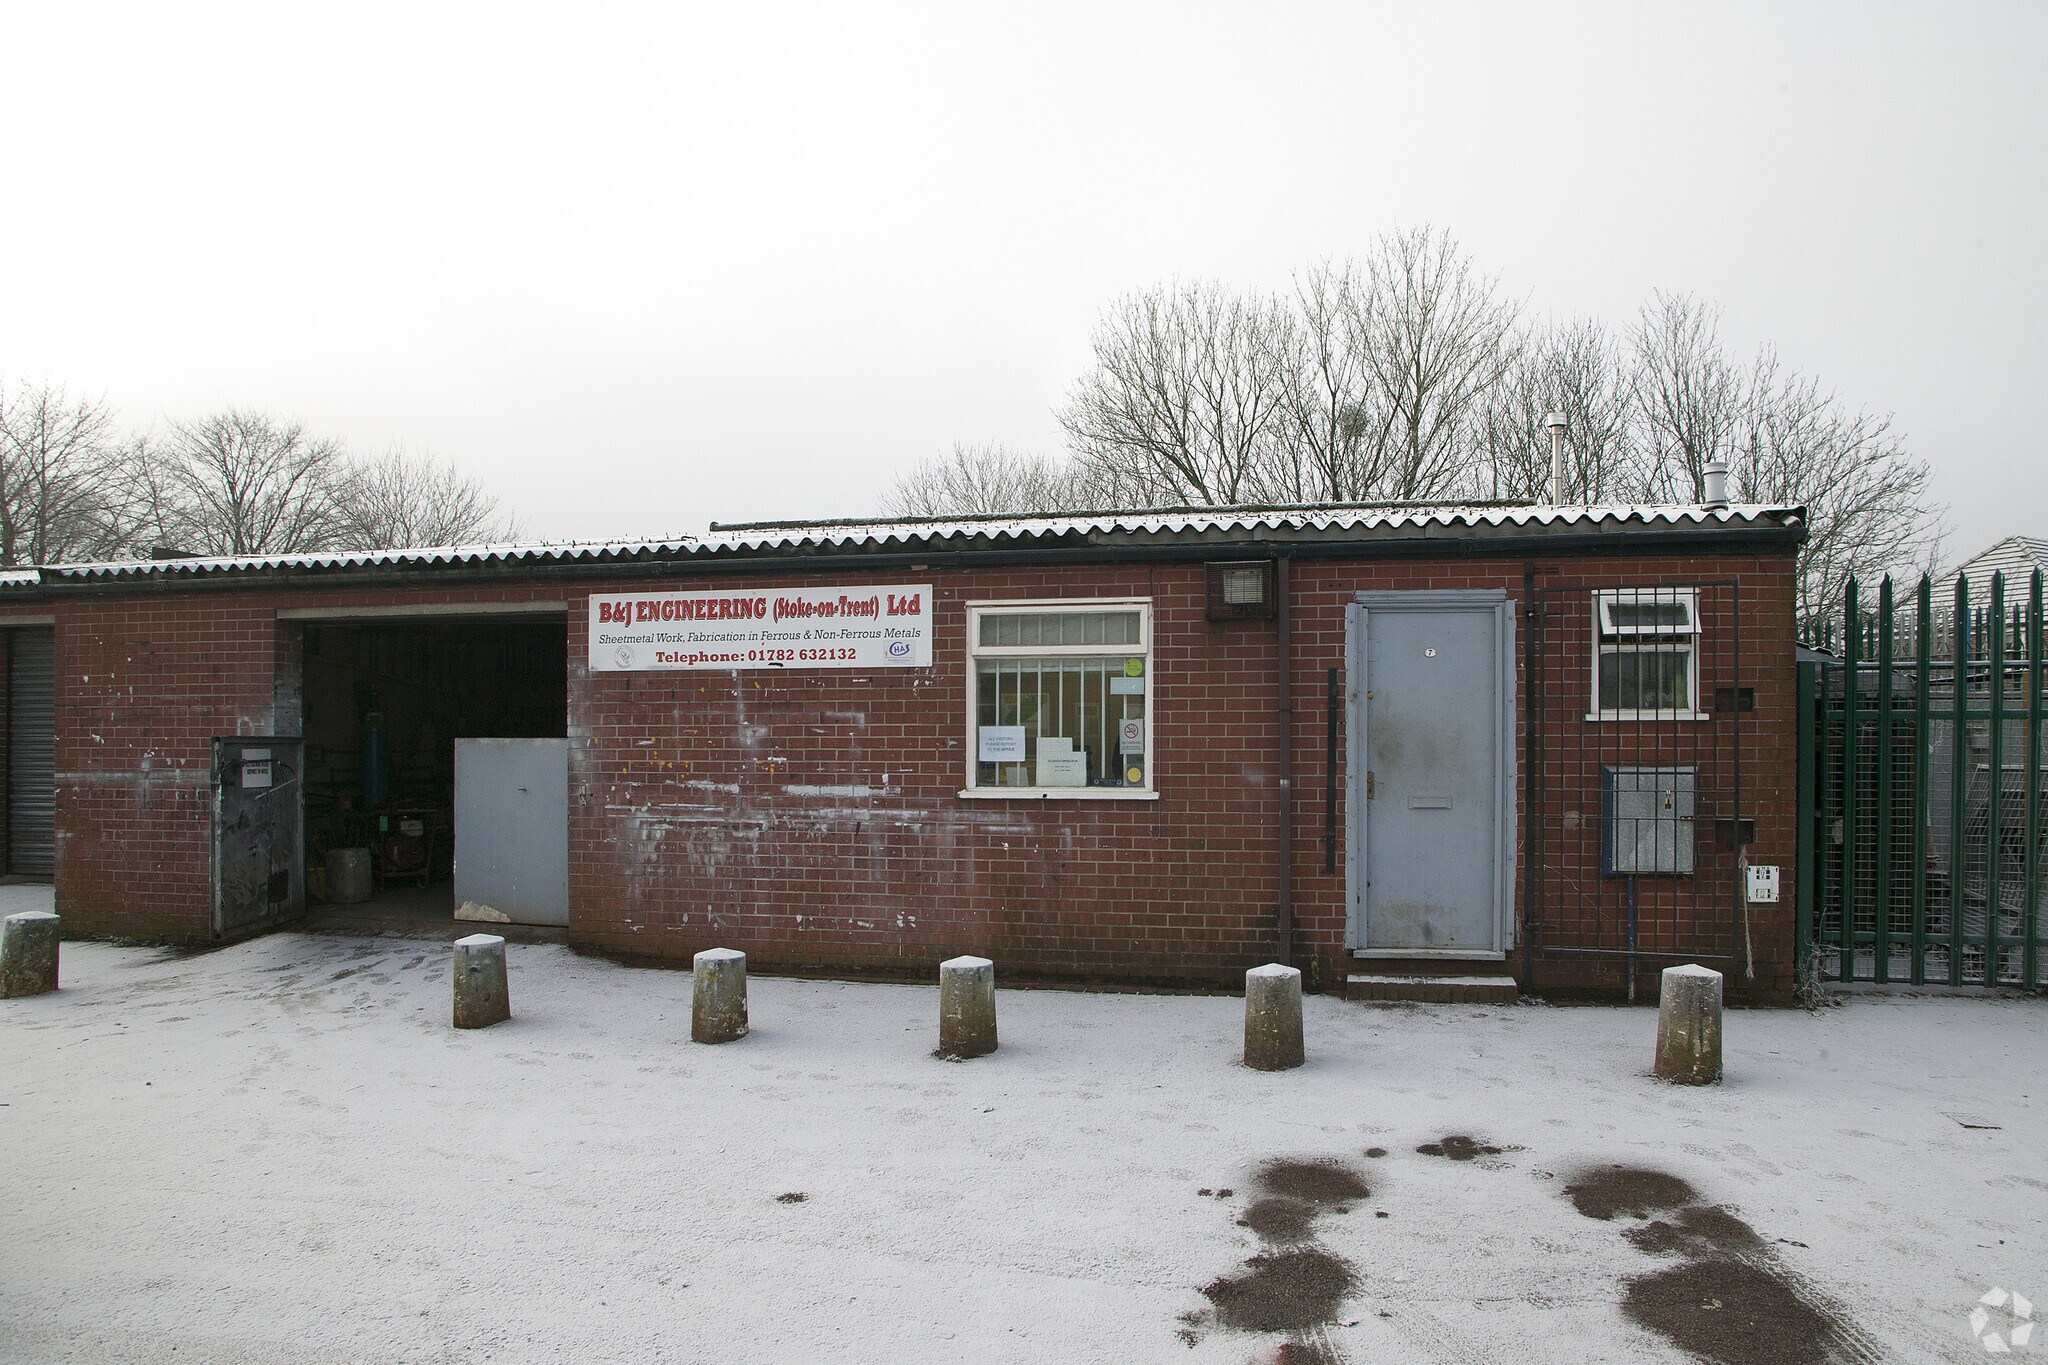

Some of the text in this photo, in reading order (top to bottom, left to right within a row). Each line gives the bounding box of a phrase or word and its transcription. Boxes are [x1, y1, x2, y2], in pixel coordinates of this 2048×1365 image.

[599, 594, 921, 628] B&J ENGINEERING (Stoke-on-Trent) Ltd
[599, 627, 921, 644] Sheetmetal Work, Fabrication in Ferrous & Non-Ferrous Metals
[656, 648, 857, 666] Telephone: 01782 632132
